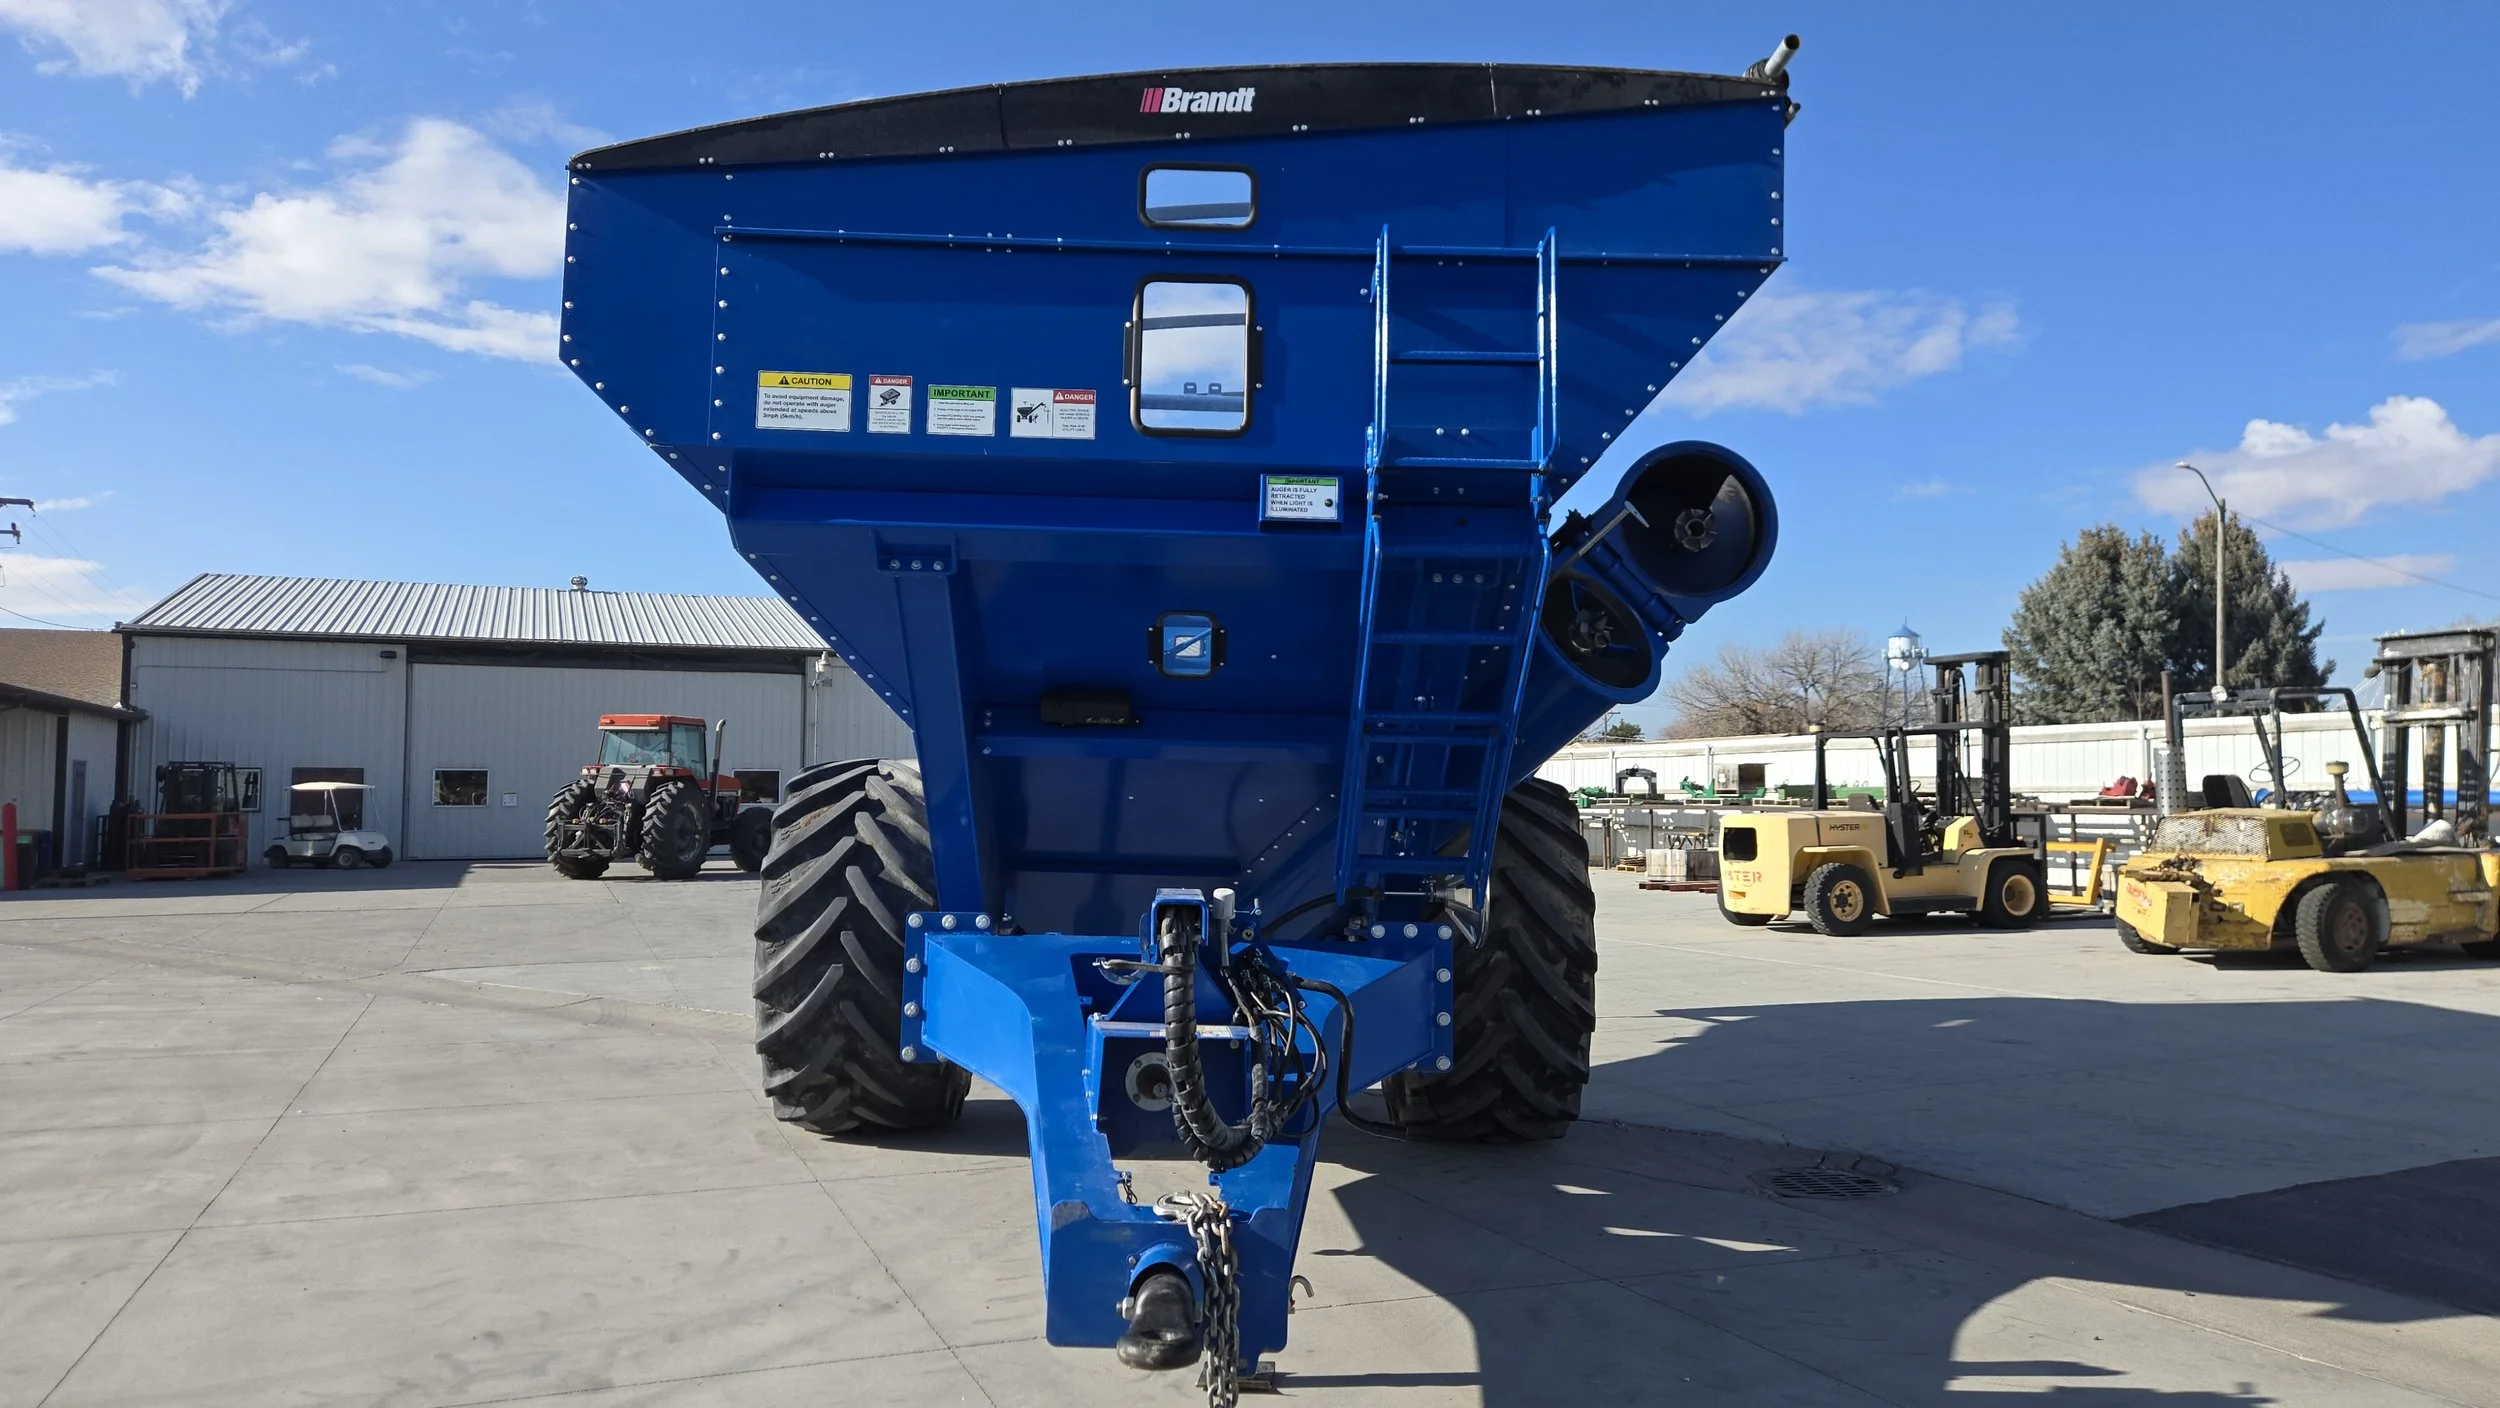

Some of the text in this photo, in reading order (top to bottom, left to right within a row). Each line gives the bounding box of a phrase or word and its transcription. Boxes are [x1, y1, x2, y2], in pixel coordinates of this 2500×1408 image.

[1160, 87, 1256, 113] Brandt
[791, 377, 832, 386] CAUTION
[933, 388, 990, 399] IMPORTANT
[1064, 393, 1094, 401] DANGER
[1829, 823, 1860, 831] HYSTER
[1724, 870, 1762, 883] STER
